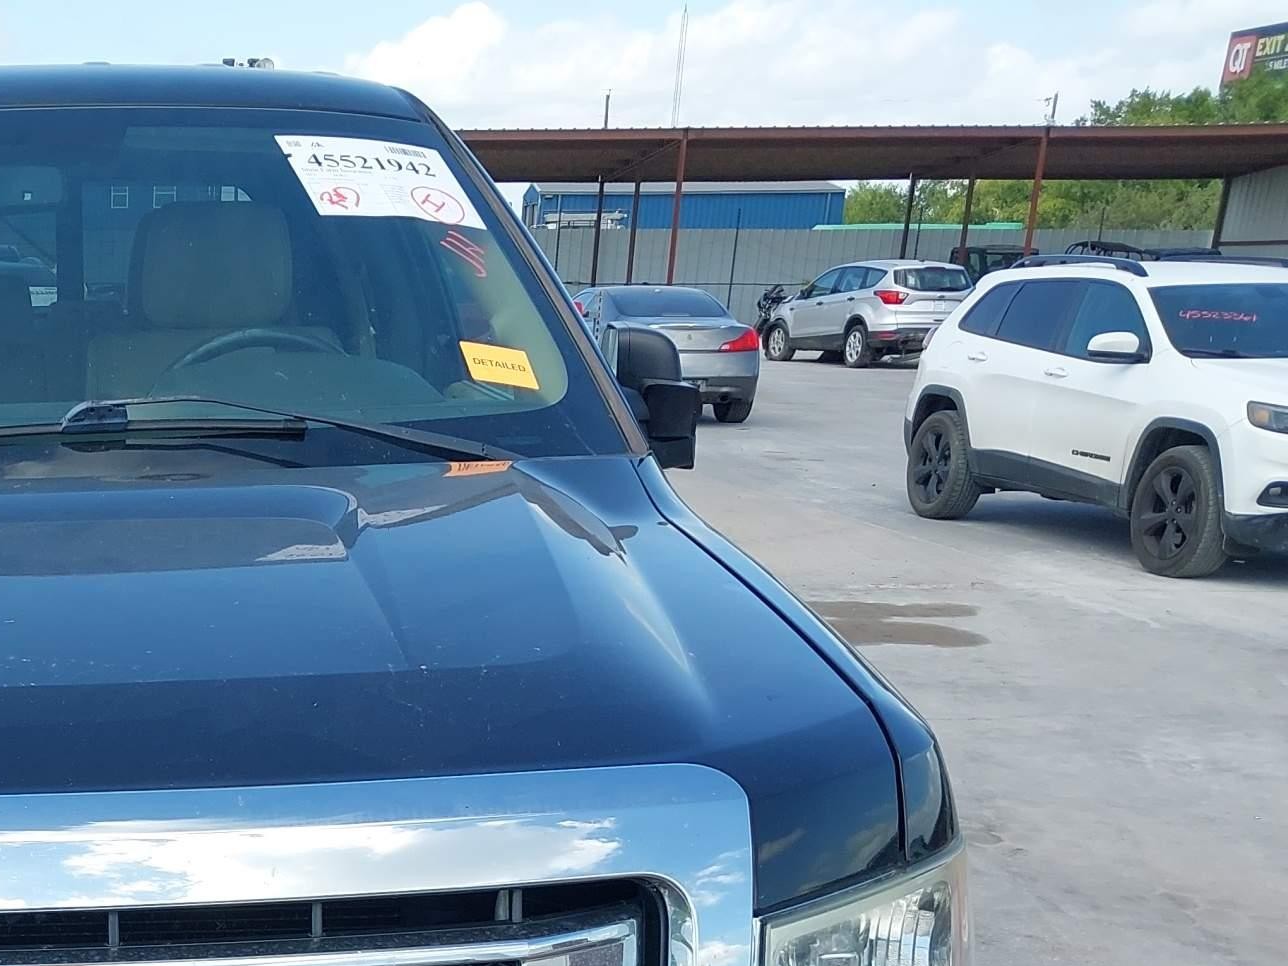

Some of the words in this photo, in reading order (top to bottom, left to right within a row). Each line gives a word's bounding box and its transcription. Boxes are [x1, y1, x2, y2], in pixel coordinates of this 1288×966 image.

[1255, 34, 1286, 57] EXIT
[1229, 42, 1251, 74] QT
[307, 153, 437, 178] 45521942
[472, 357, 527, 373] DETAILED
